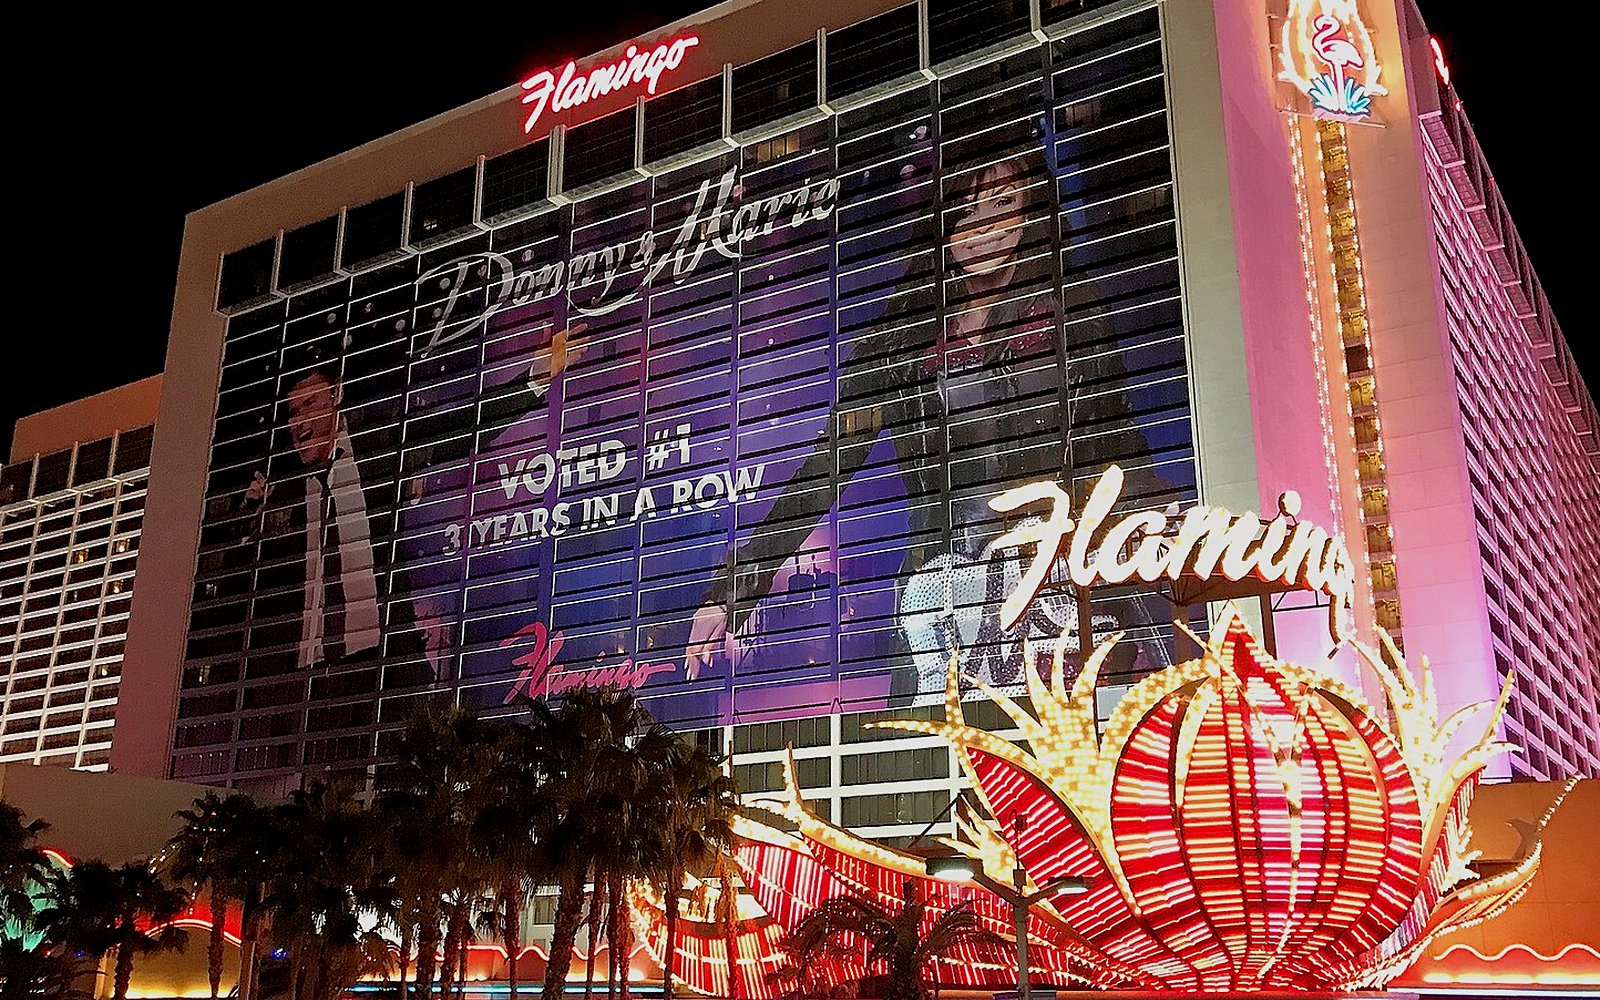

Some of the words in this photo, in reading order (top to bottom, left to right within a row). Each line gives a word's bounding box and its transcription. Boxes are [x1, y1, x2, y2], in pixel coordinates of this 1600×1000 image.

[521, 36, 699, 134] Flamingo
[406, 243, 638, 358] Donny
[636, 165, 840, 290] Marie
[498, 439, 628, 499] VOTED
[645, 423, 691, 471] #1
[442, 523, 461, 556] 3
[472, 502, 571, 549] YEARS
[580, 493, 620, 530] IN
[629, 487, 657, 522] A
[669, 464, 766, 514] ROW
[500, 621, 676, 704] Flamingo
